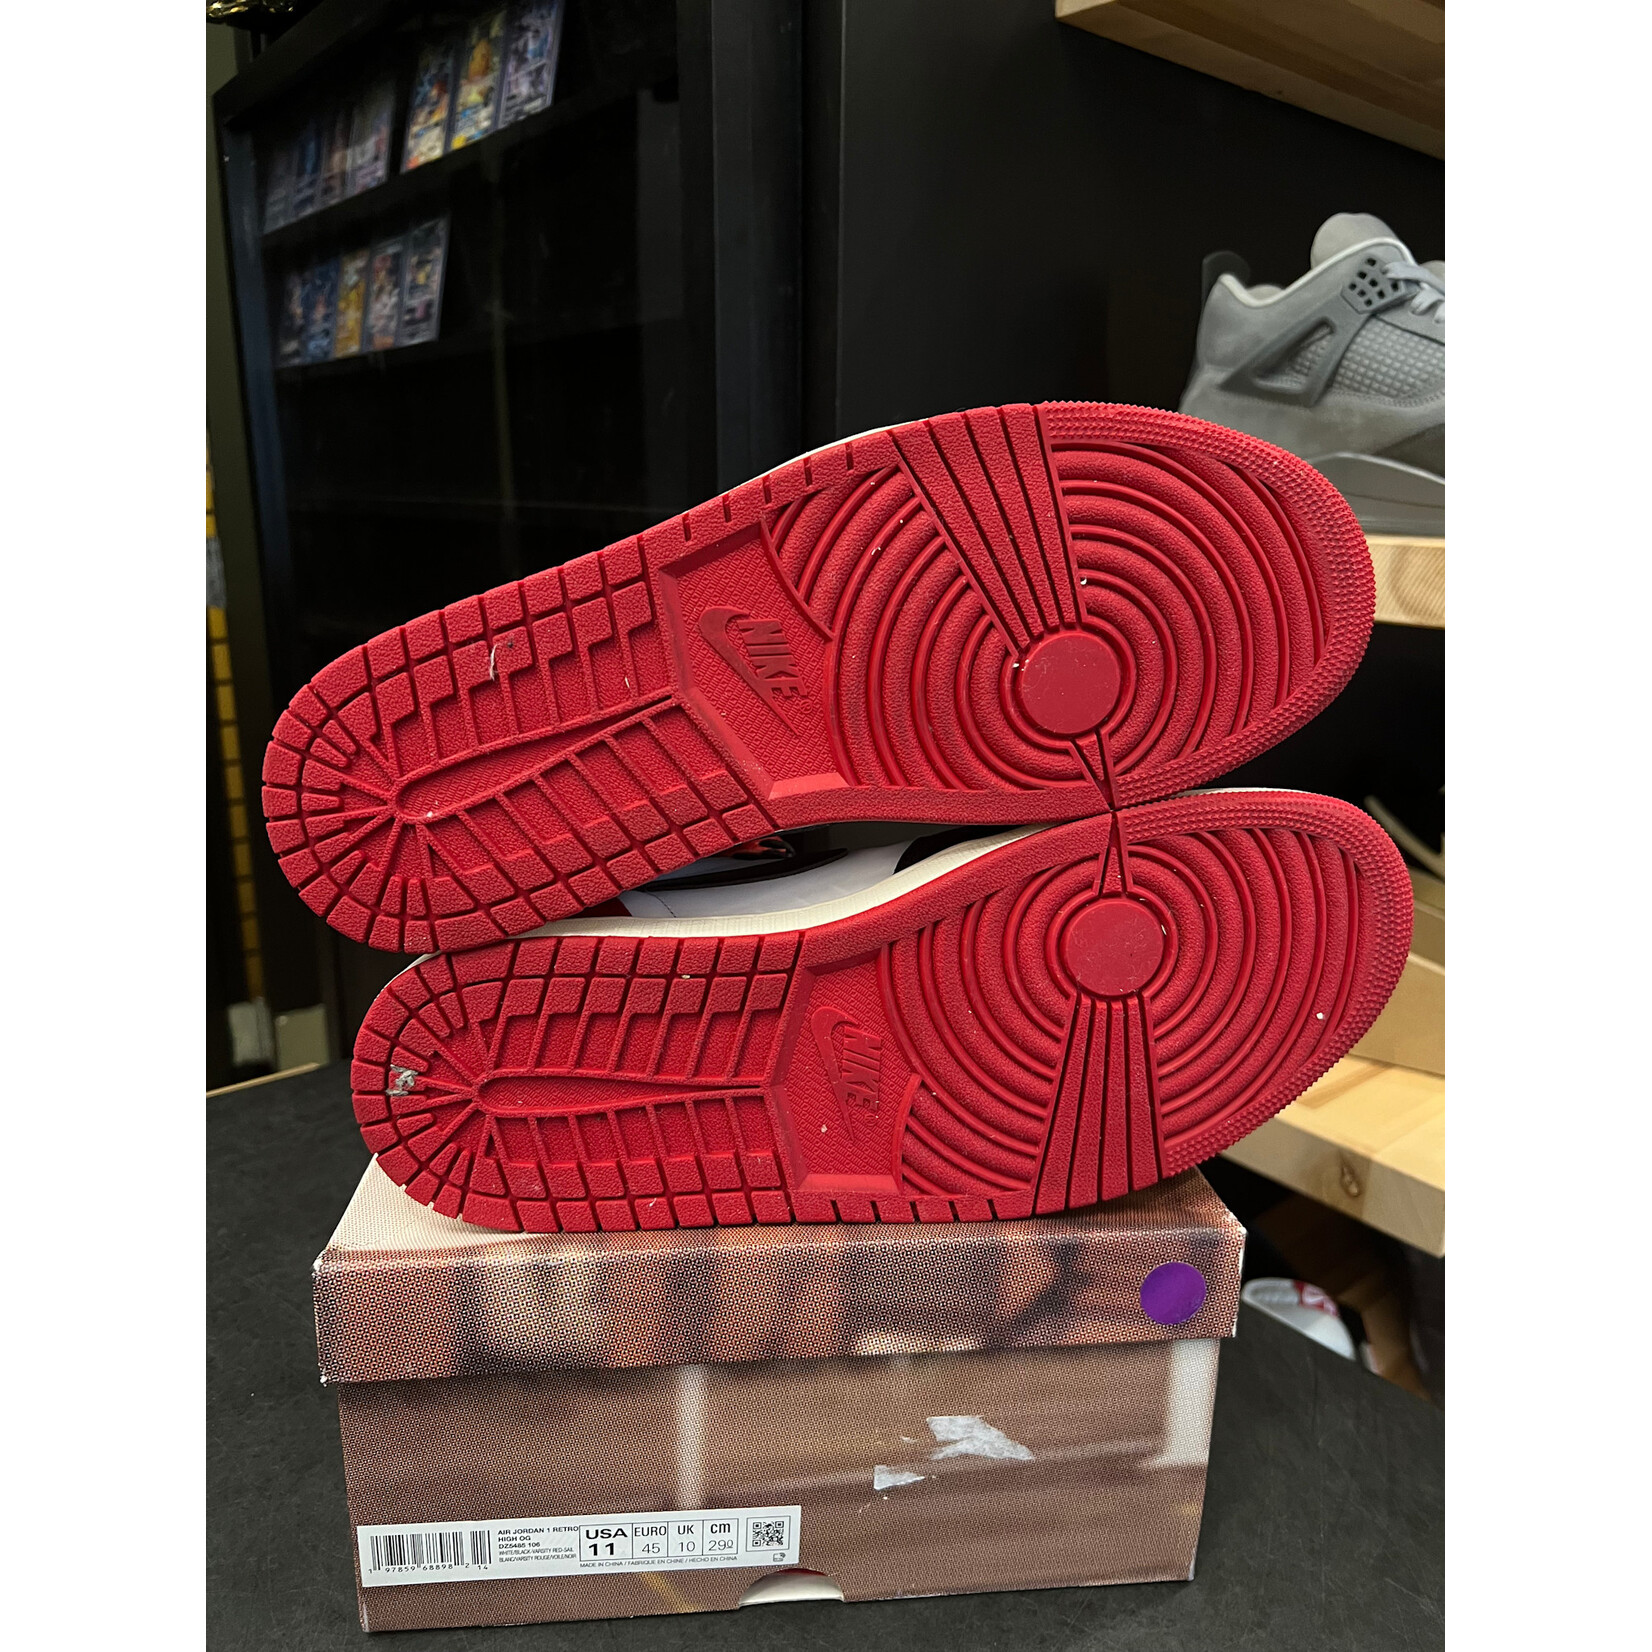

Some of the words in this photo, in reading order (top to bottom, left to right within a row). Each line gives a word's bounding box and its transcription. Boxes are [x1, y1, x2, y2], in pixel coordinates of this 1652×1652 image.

[737, 619, 807, 698] NIKE
[842, 1026, 882, 1113] NIKE
[512, 1527, 545, 1535] JORDAN
[585, 1528, 628, 1540] USA
[634, 1526, 667, 1537] EURO
[677, 1524, 695, 1535] UK
[710, 1523, 731, 1534] cm
[588, 1542, 614, 1556] 11
[641, 1543, 661, 1554] 45
[678, 1540, 696, 1552] 10
[422, 1563, 454, 1571] 68898
